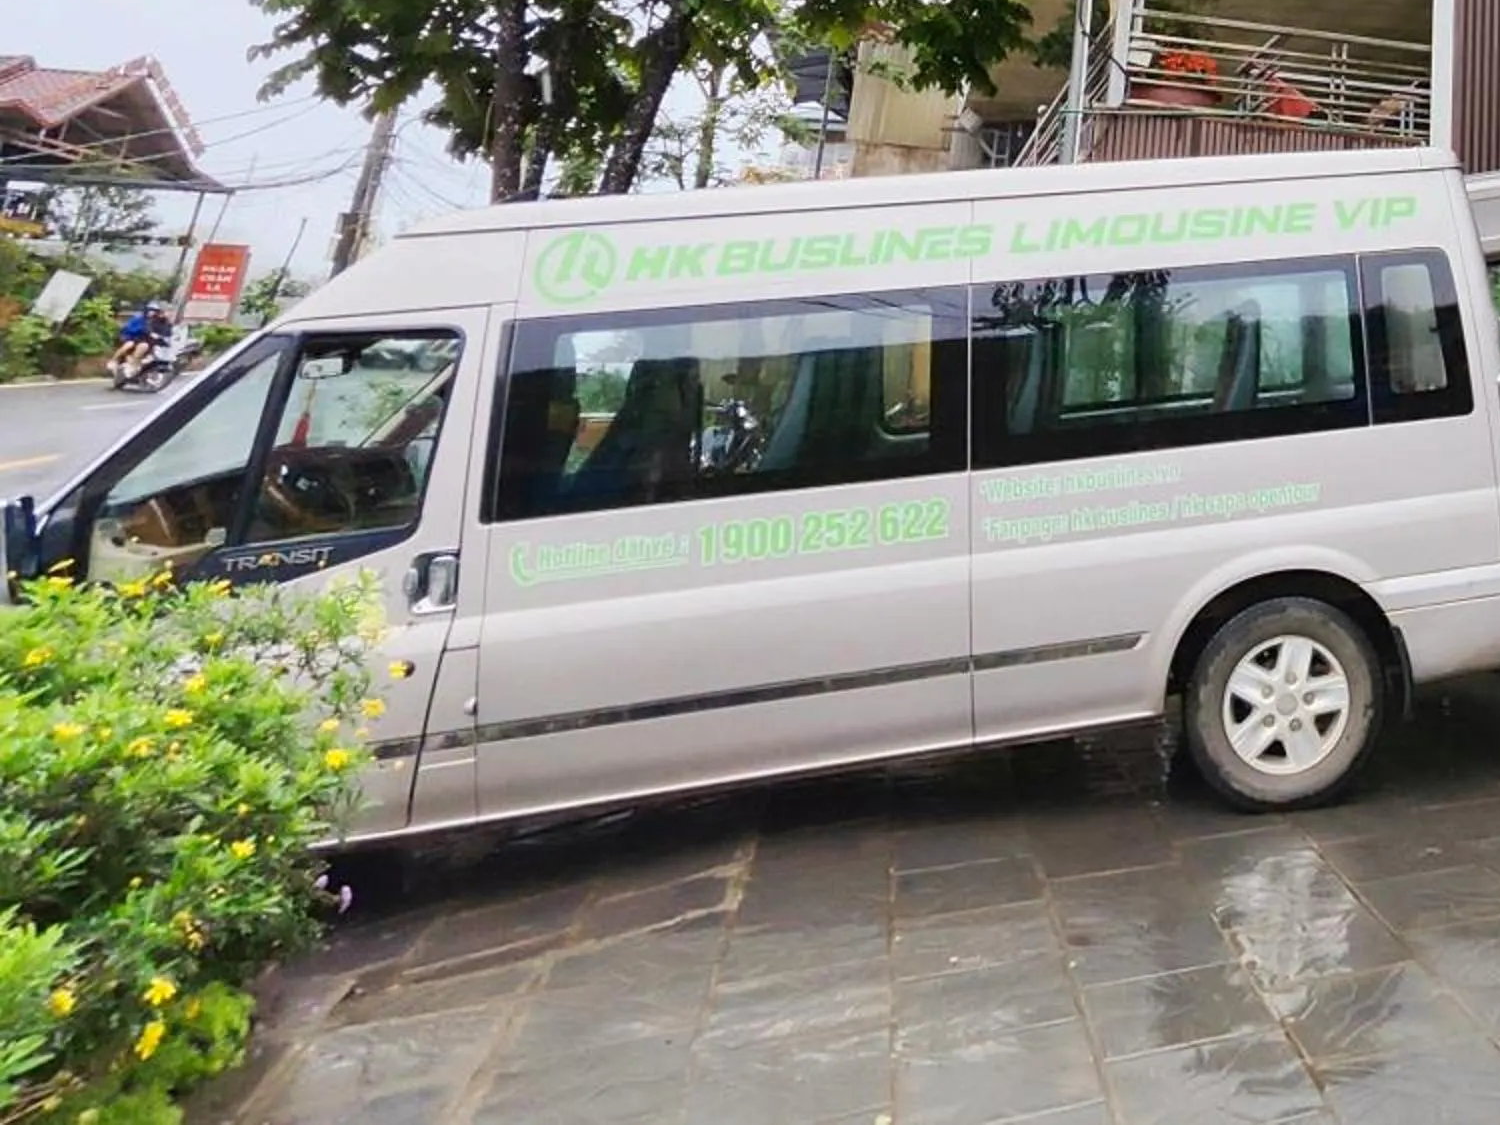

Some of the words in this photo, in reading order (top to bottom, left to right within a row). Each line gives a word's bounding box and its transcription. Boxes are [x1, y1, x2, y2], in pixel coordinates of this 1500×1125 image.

[714, 224, 995, 276] BUSLINES
[1009, 202, 1318, 254] LIMOUSINE
[1333, 196, 1418, 231] VIP
[699, 513, 793, 567] 1900
[797, 506, 874, 555] 252
[878, 497, 950, 545] 622
